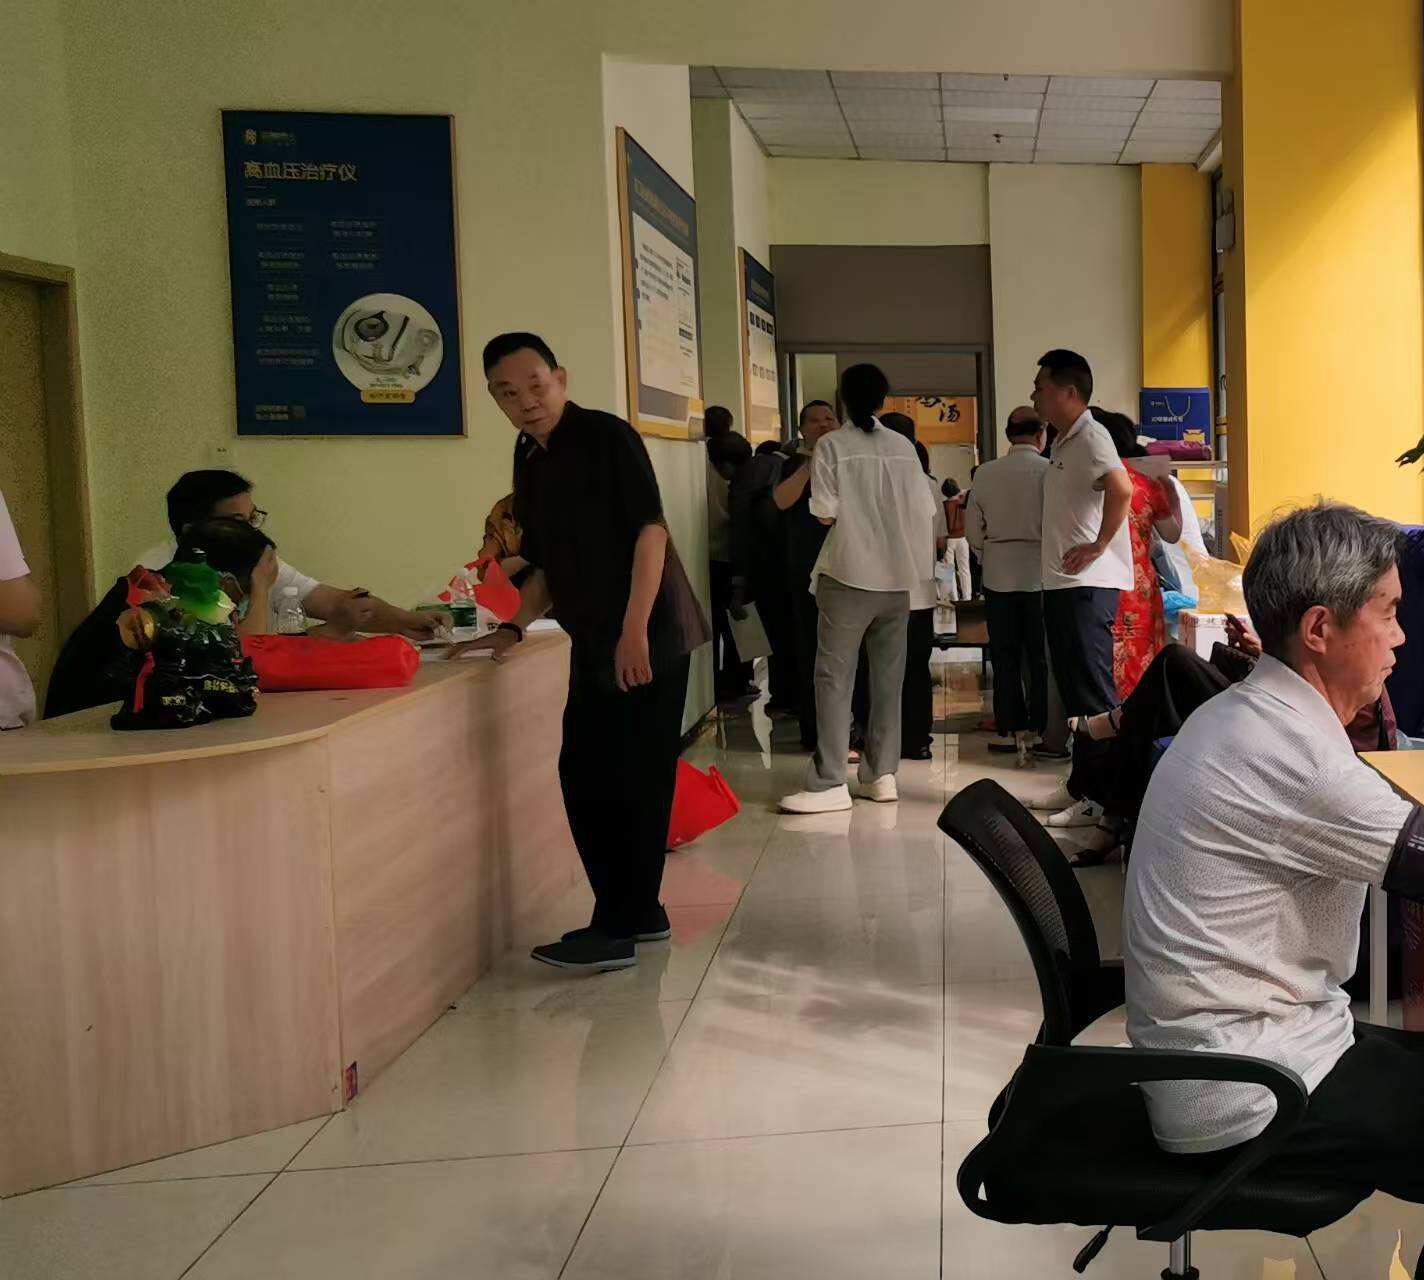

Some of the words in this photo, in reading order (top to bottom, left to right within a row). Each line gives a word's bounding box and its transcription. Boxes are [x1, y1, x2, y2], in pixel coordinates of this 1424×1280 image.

[244, 161, 357, 182] 高血压治疗仪
